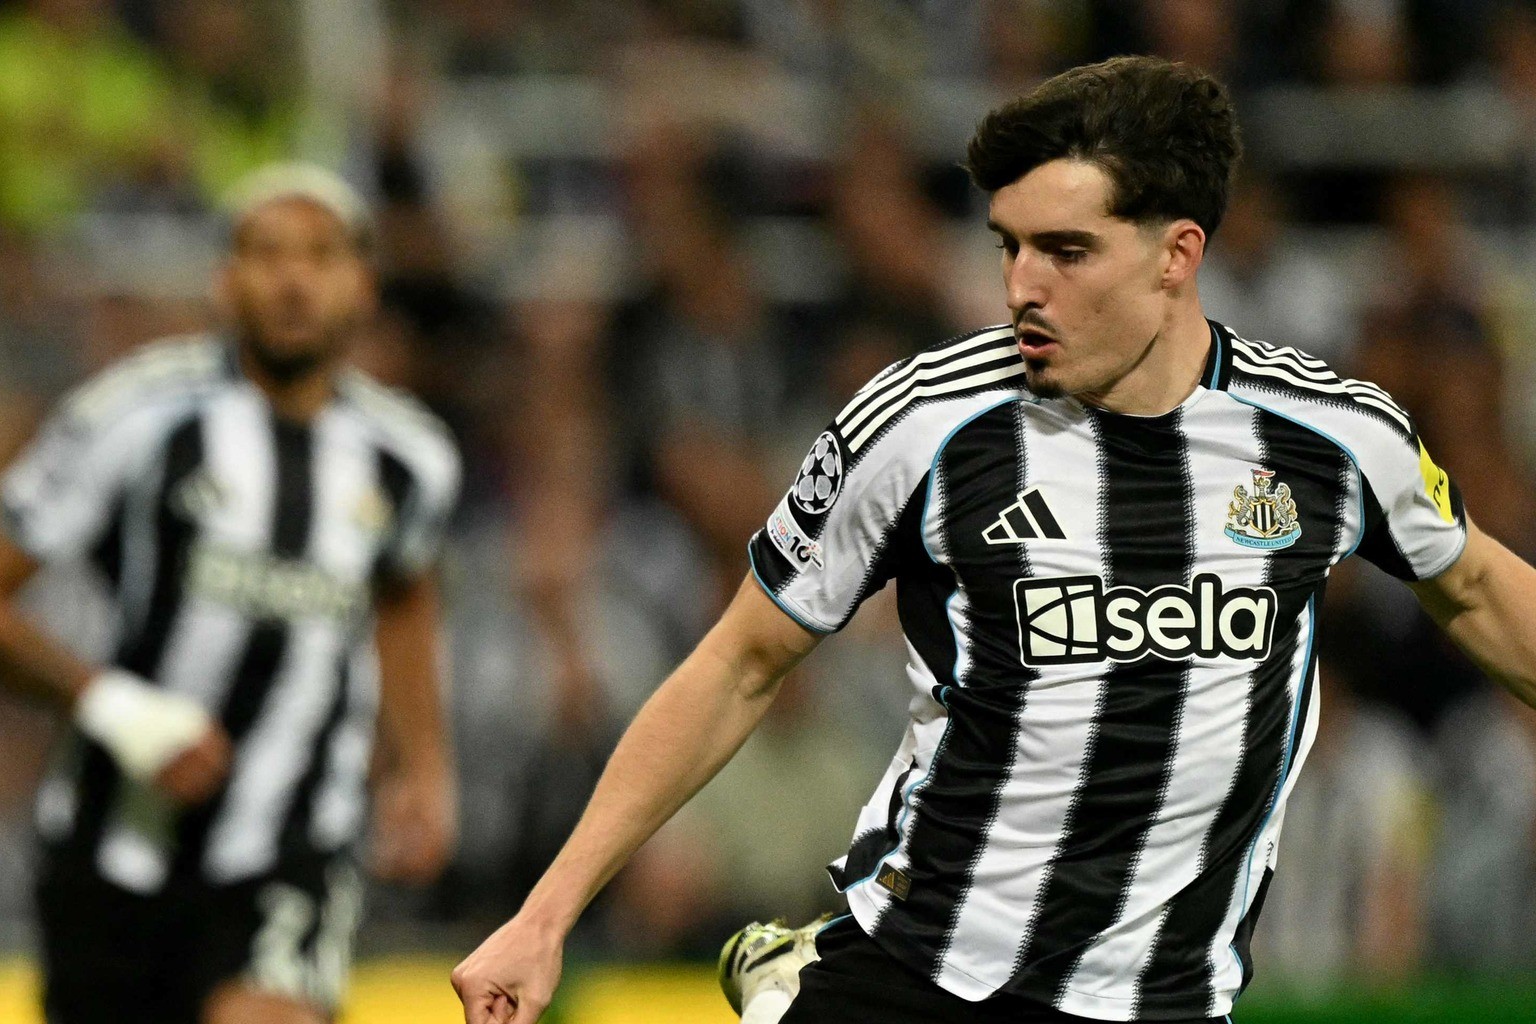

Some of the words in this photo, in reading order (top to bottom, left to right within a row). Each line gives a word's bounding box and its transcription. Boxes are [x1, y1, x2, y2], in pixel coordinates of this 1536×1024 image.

[1235, 536, 1270, 547] NEWCASTLE
[1271, 536, 1292, 547] UNITED
[1105, 581, 1269, 652] sela
